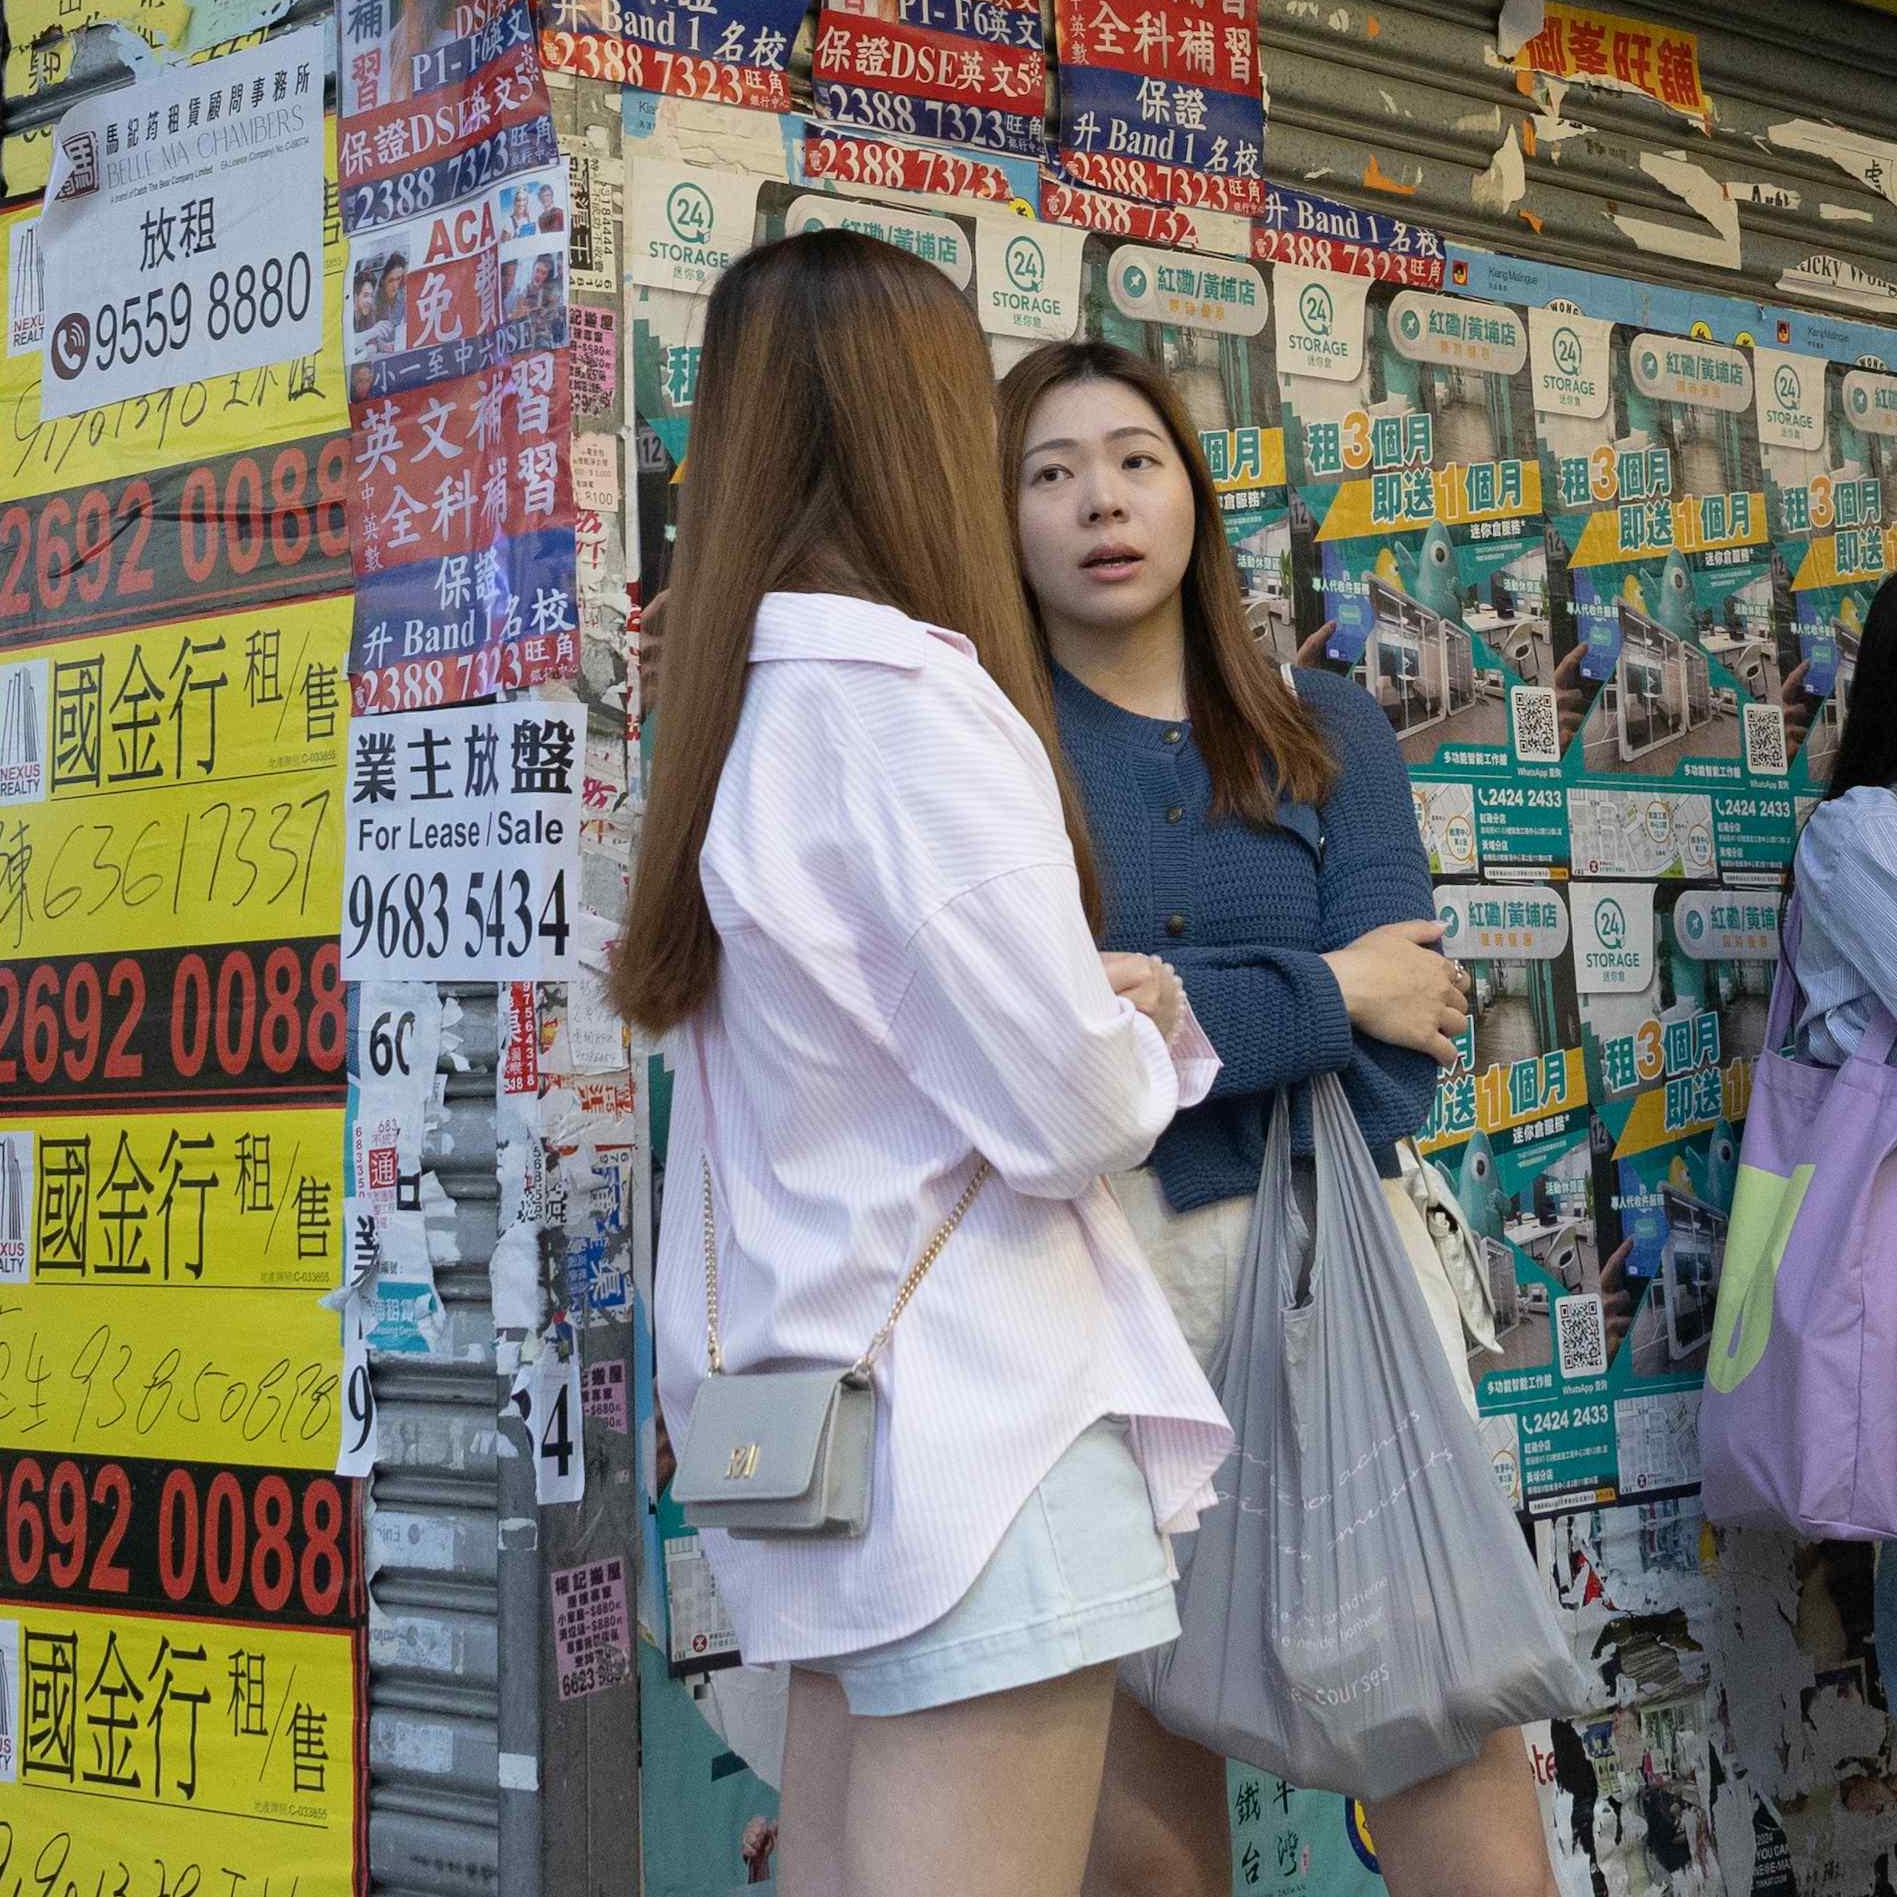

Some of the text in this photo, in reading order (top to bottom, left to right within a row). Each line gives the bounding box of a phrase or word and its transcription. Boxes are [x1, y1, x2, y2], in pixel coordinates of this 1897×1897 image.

[558, 32, 744, 105] 2388 7323
[714, 21, 787, 71] 名校
[1090, 0, 1253, 85] 全科補習
[107, 105, 305, 188] BELLE CHAMBERS
[1109, 118, 1260, 179] Band 名校
[140, 196, 217, 272] 放租
[1013, 254, 1039, 275] 24
[96, 250, 311, 370] 9559 8880
[992, 290, 1061, 316] STORAGE
[1156, 265, 1257, 306] 紅磡/黃埔店
[1289, 333, 1348, 359] STORAGE
[1308, 410, 1434, 476] 租3個月
[1560, 447, 1671, 502] 租3個月
[180, 438, 351, 583] 0088
[1371, 459, 1523, 522] 即送1個月
[1618, 491, 1750, 550] 即送1個月
[50, 634, 228, 794] 國金行
[0, 764, 40, 782] NEXUS
[1, 780, 41, 797] REALTY
[353, 719, 574, 805] 業主放盤
[1489, 789, 1562, 807] 2424 2433
[359, 817, 401, 852] For
[347, 868, 571, 959] 9683 5434
[171, 943, 347, 1079] 0088
[36, 1129, 218, 1277] 國金行
[1534, 1405, 1609, 1434] 2424 2433
[23, 1627, 210, 1800] 國金行
